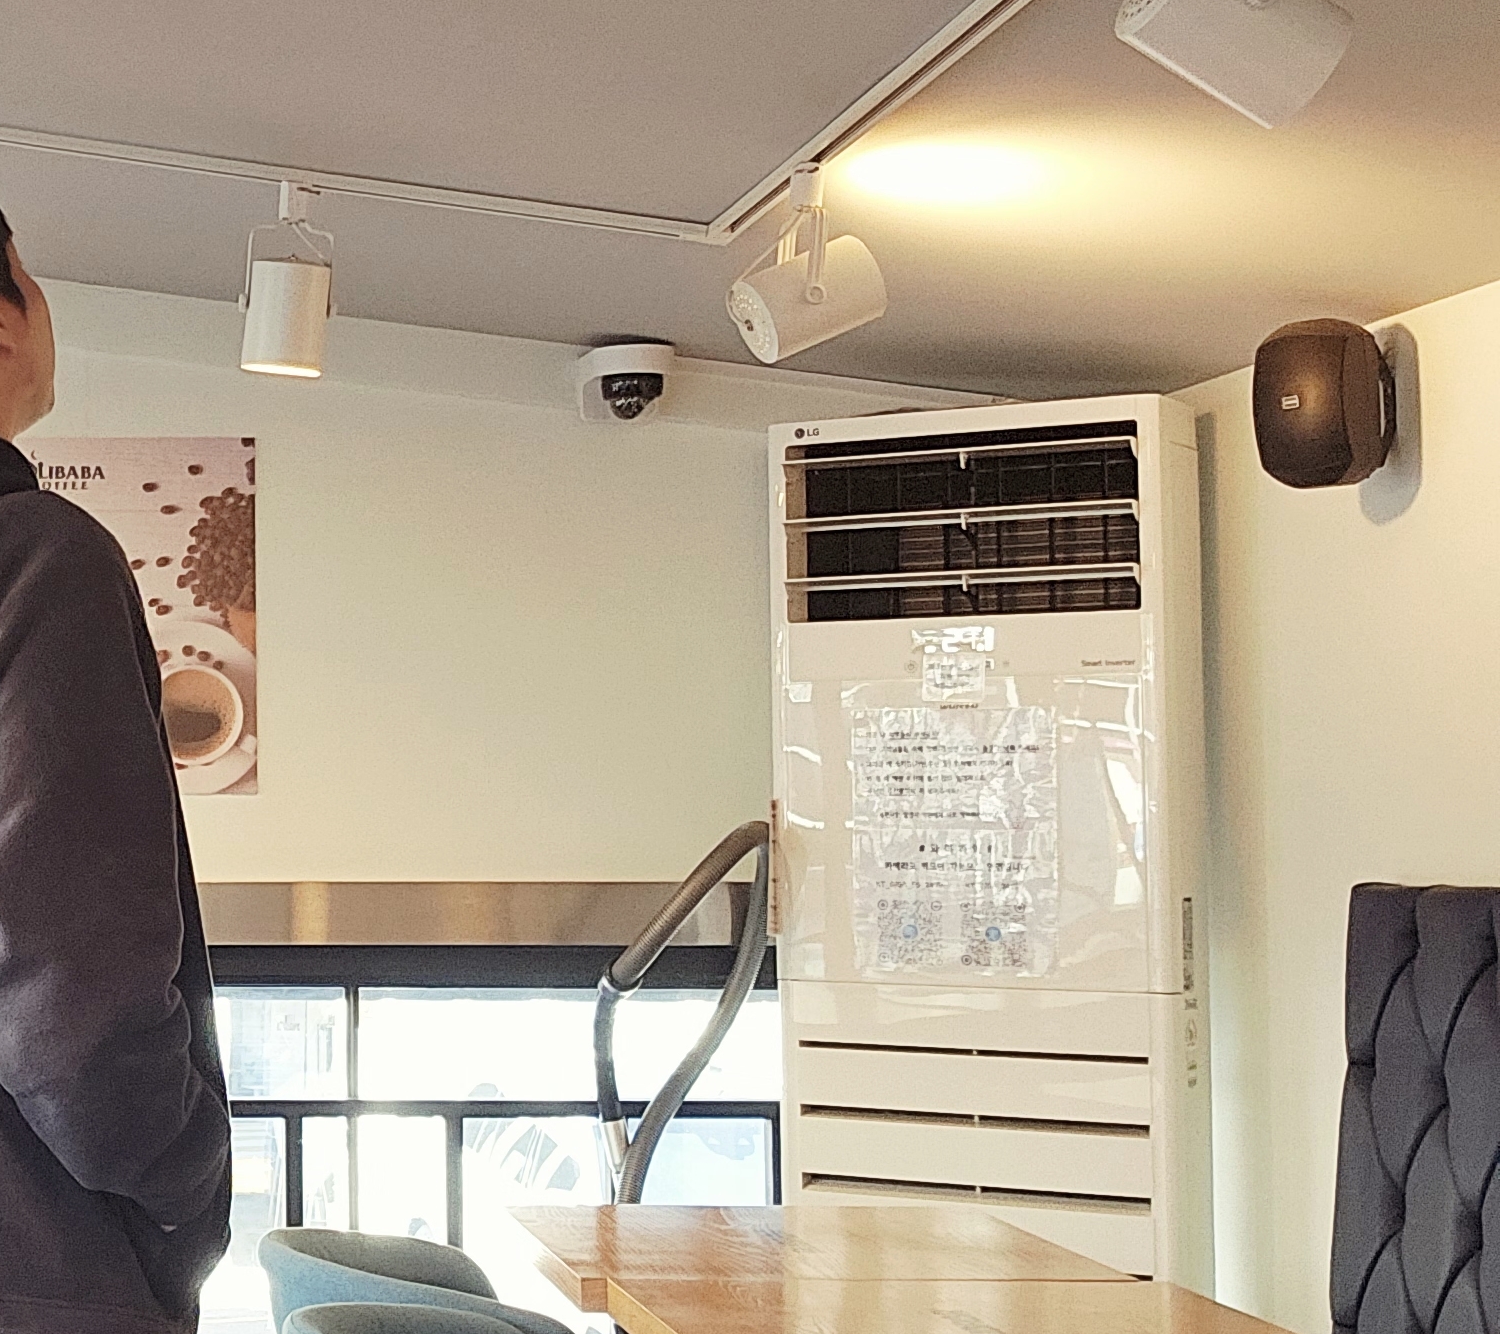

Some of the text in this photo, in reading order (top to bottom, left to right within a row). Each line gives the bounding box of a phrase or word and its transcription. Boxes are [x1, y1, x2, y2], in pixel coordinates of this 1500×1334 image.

[806, 428, 820, 437] LG
[31, 461, 106, 480] LIBABA
[41, 481, 89, 491] OFFEE
